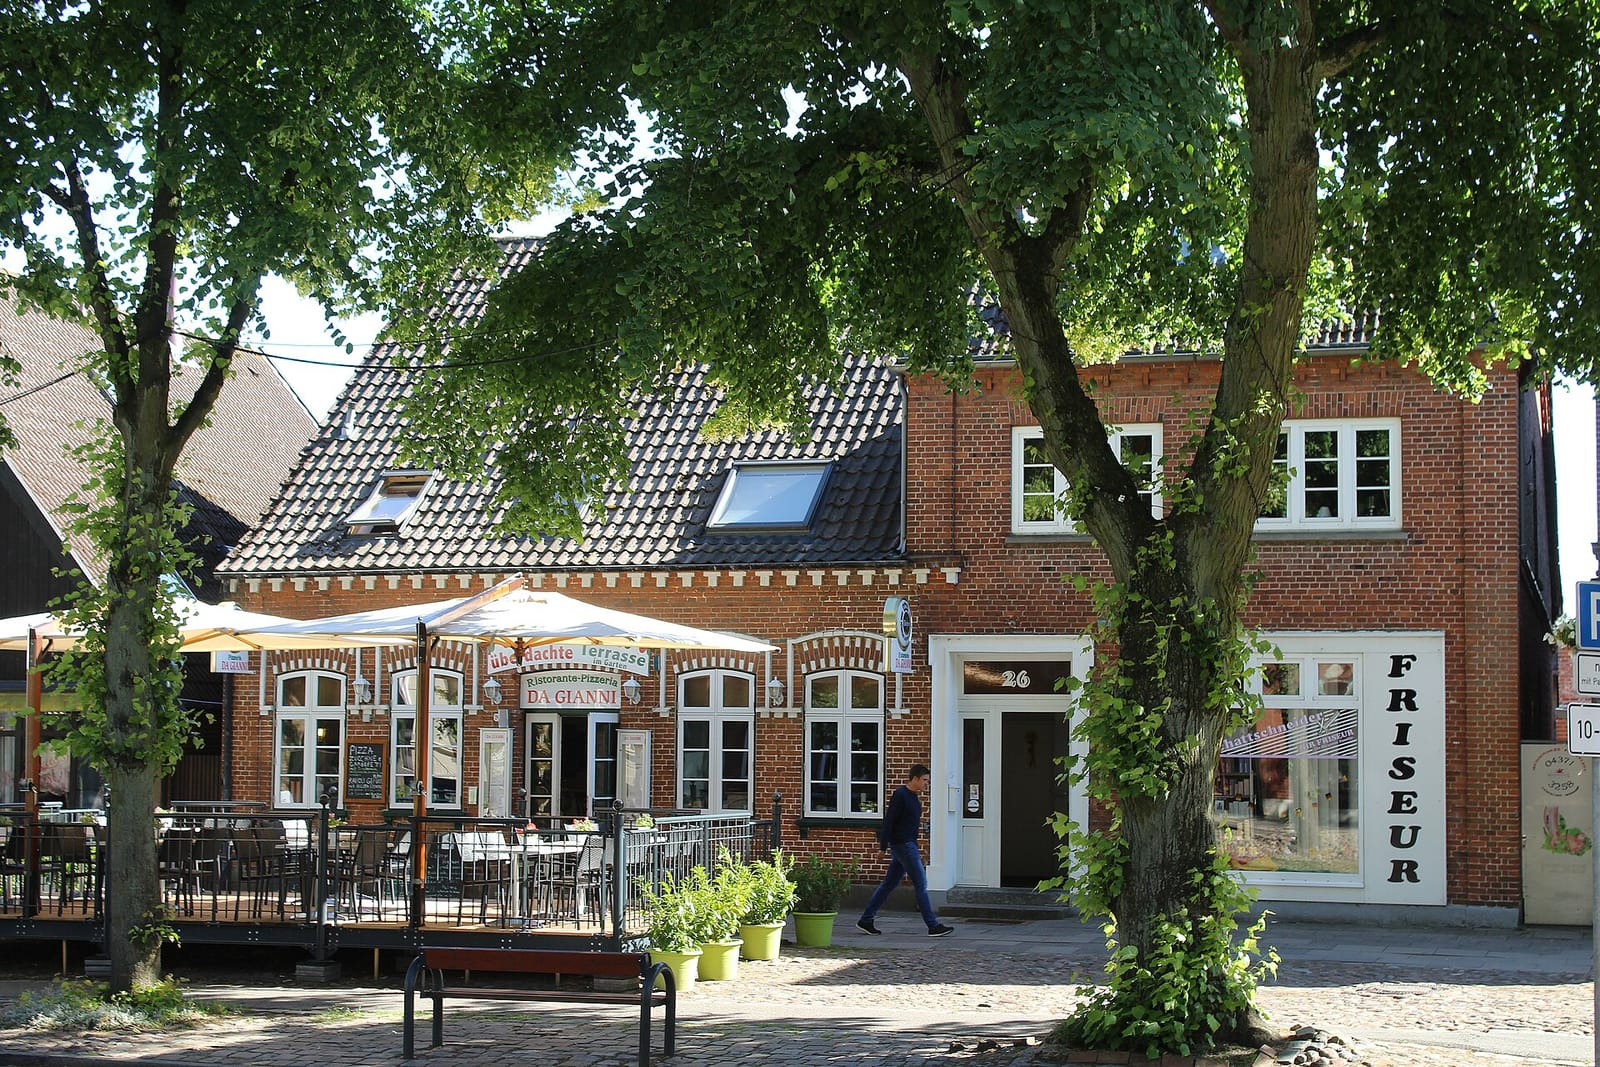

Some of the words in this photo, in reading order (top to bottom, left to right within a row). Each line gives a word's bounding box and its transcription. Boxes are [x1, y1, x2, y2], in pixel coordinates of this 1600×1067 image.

[490, 645, 574, 669] übedachte
[581, 644, 646, 667] Terrasse
[593, 657, 602, 665] im
[604, 659, 627, 670] Garten
[527, 674, 619, 688] Ristorante-Pizzeria
[1001, 669, 1031, 688] 26
[528, 690, 551, 704] DA
[554, 689, 617, 704] GIANNI
[1223, 712, 1324, 750] hattschneider
[1316, 729, 1355, 746] FRISEUR
[349, 745, 374, 755] PIZZA
[1386, 654, 1422, 884] FRISEUR
[1545, 756, 1575, 767] 04371
